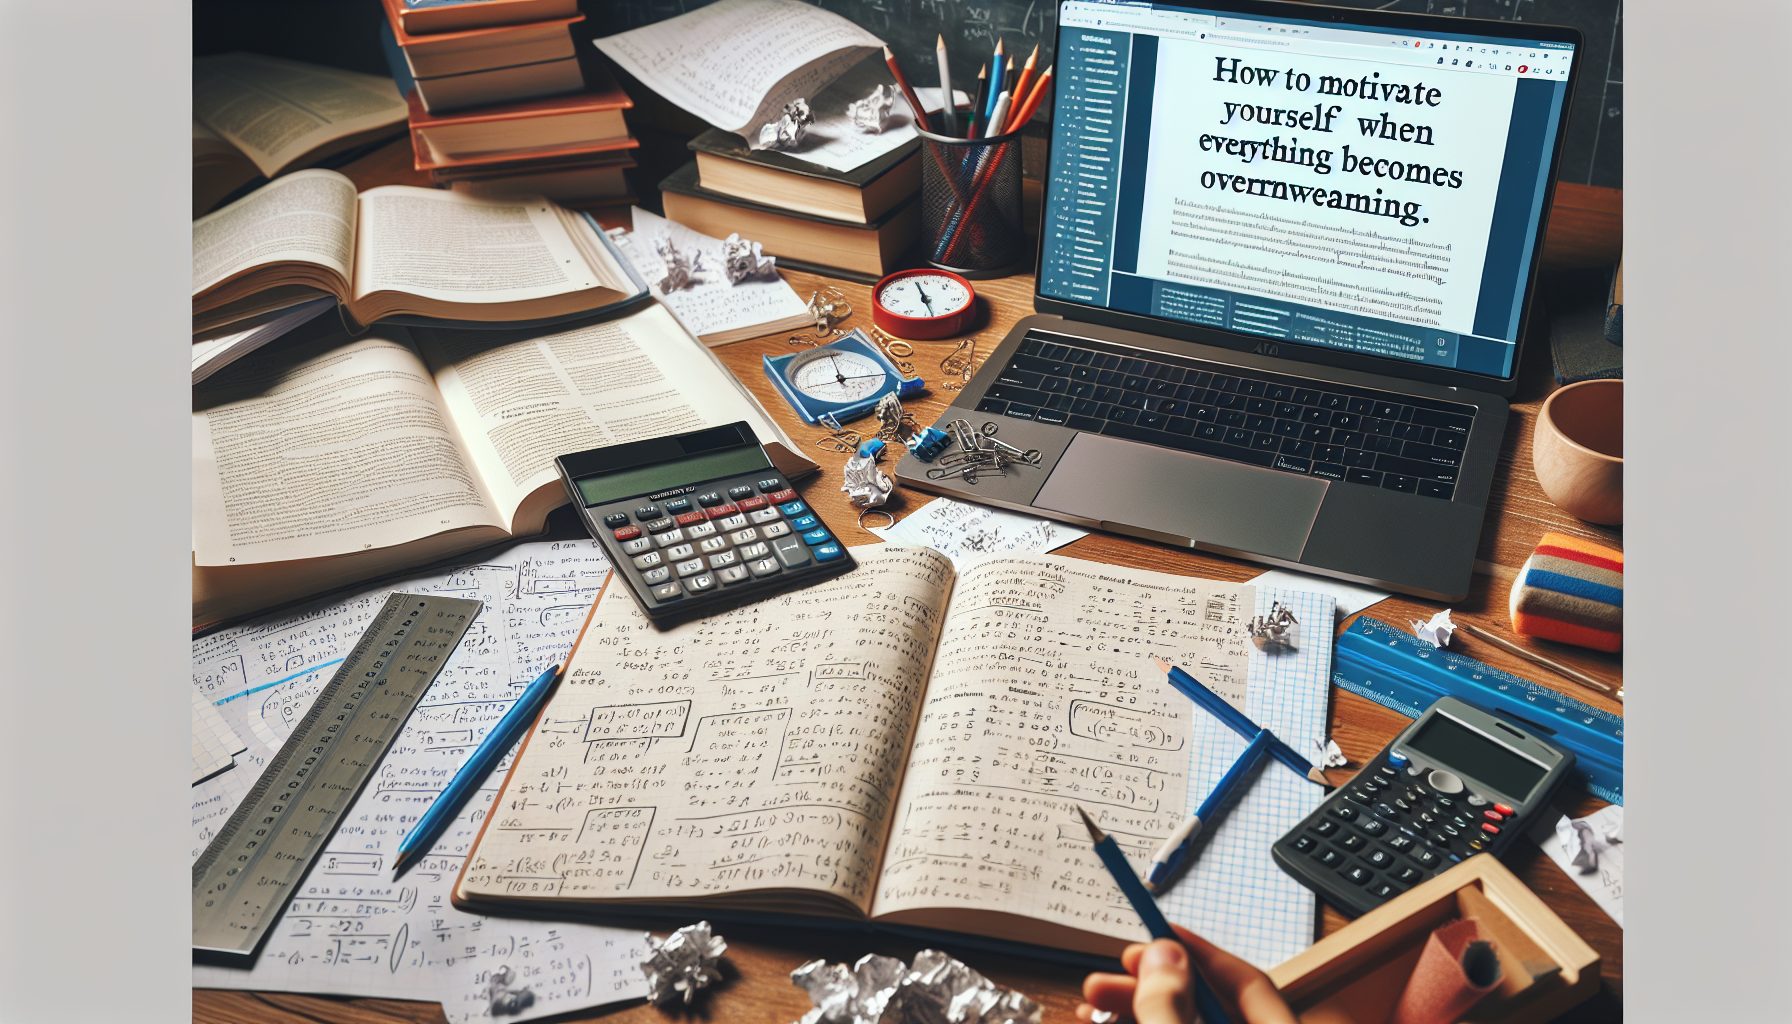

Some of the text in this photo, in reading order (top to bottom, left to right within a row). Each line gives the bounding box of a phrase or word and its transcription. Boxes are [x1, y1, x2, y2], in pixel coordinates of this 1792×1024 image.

[1213, 56, 1442, 107] How to motivate
[1220, 102, 1435, 145] yourself when
[1199, 133, 1463, 189] everything becomes
